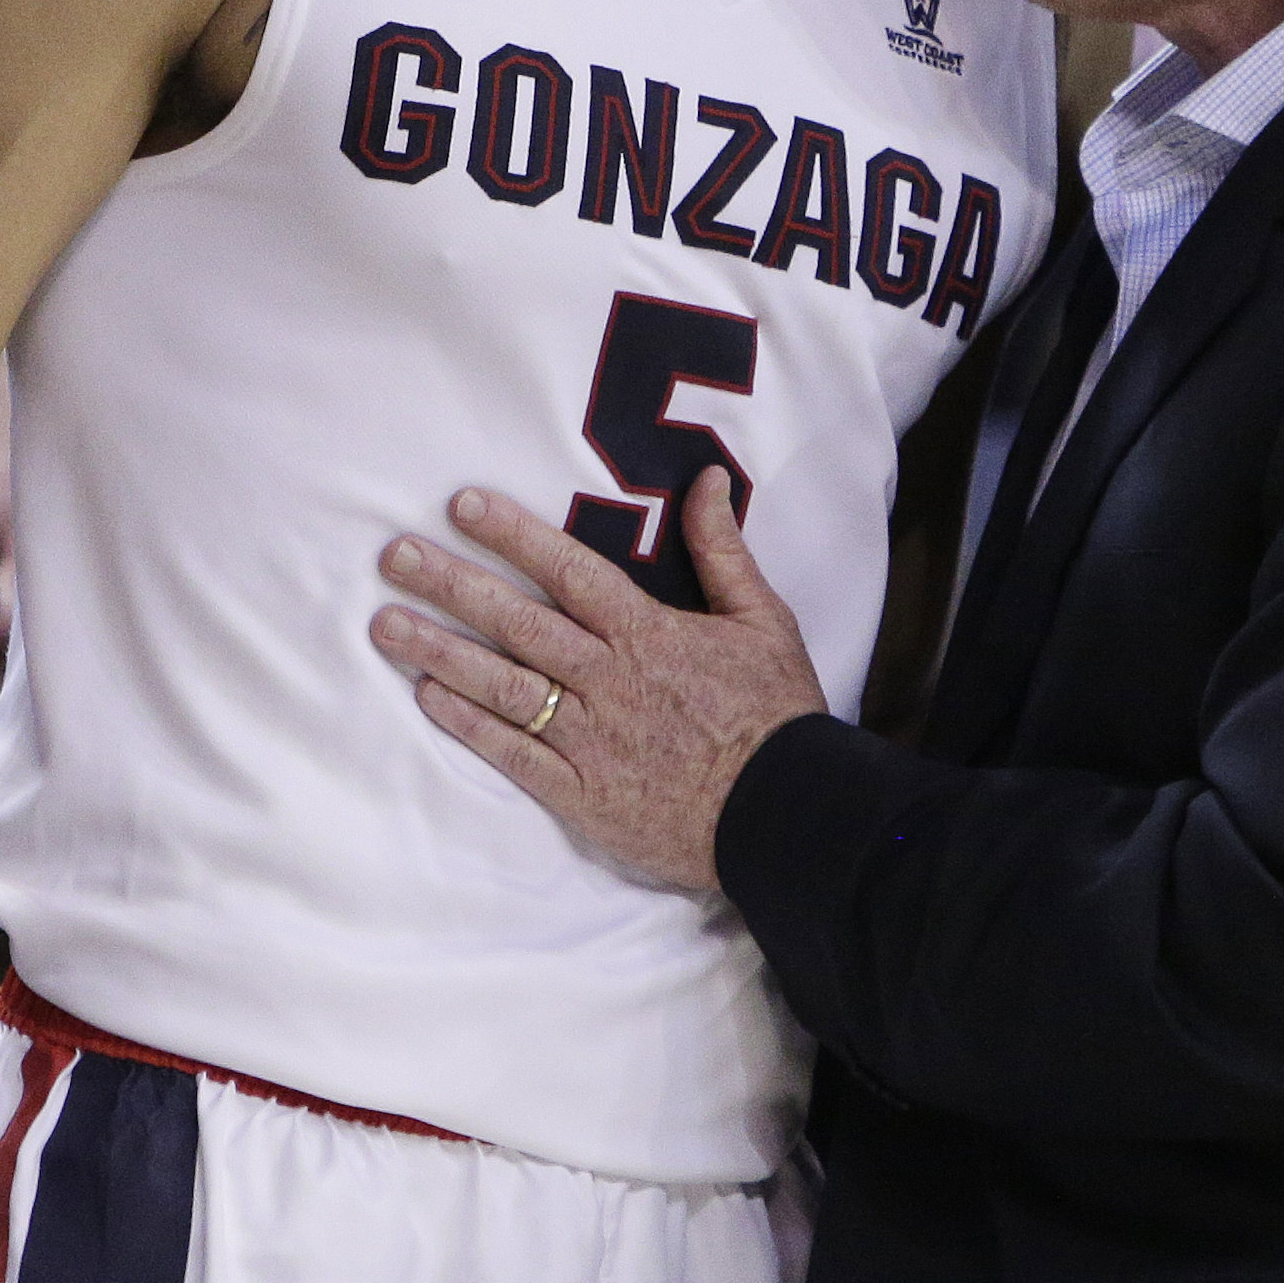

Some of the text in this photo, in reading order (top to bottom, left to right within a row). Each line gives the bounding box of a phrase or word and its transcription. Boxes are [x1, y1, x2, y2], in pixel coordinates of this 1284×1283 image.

[340, 21, 1002, 341] GONZAGA
[885, 27, 964, 66] WEST COAST
[563, 290, 758, 614] 5
